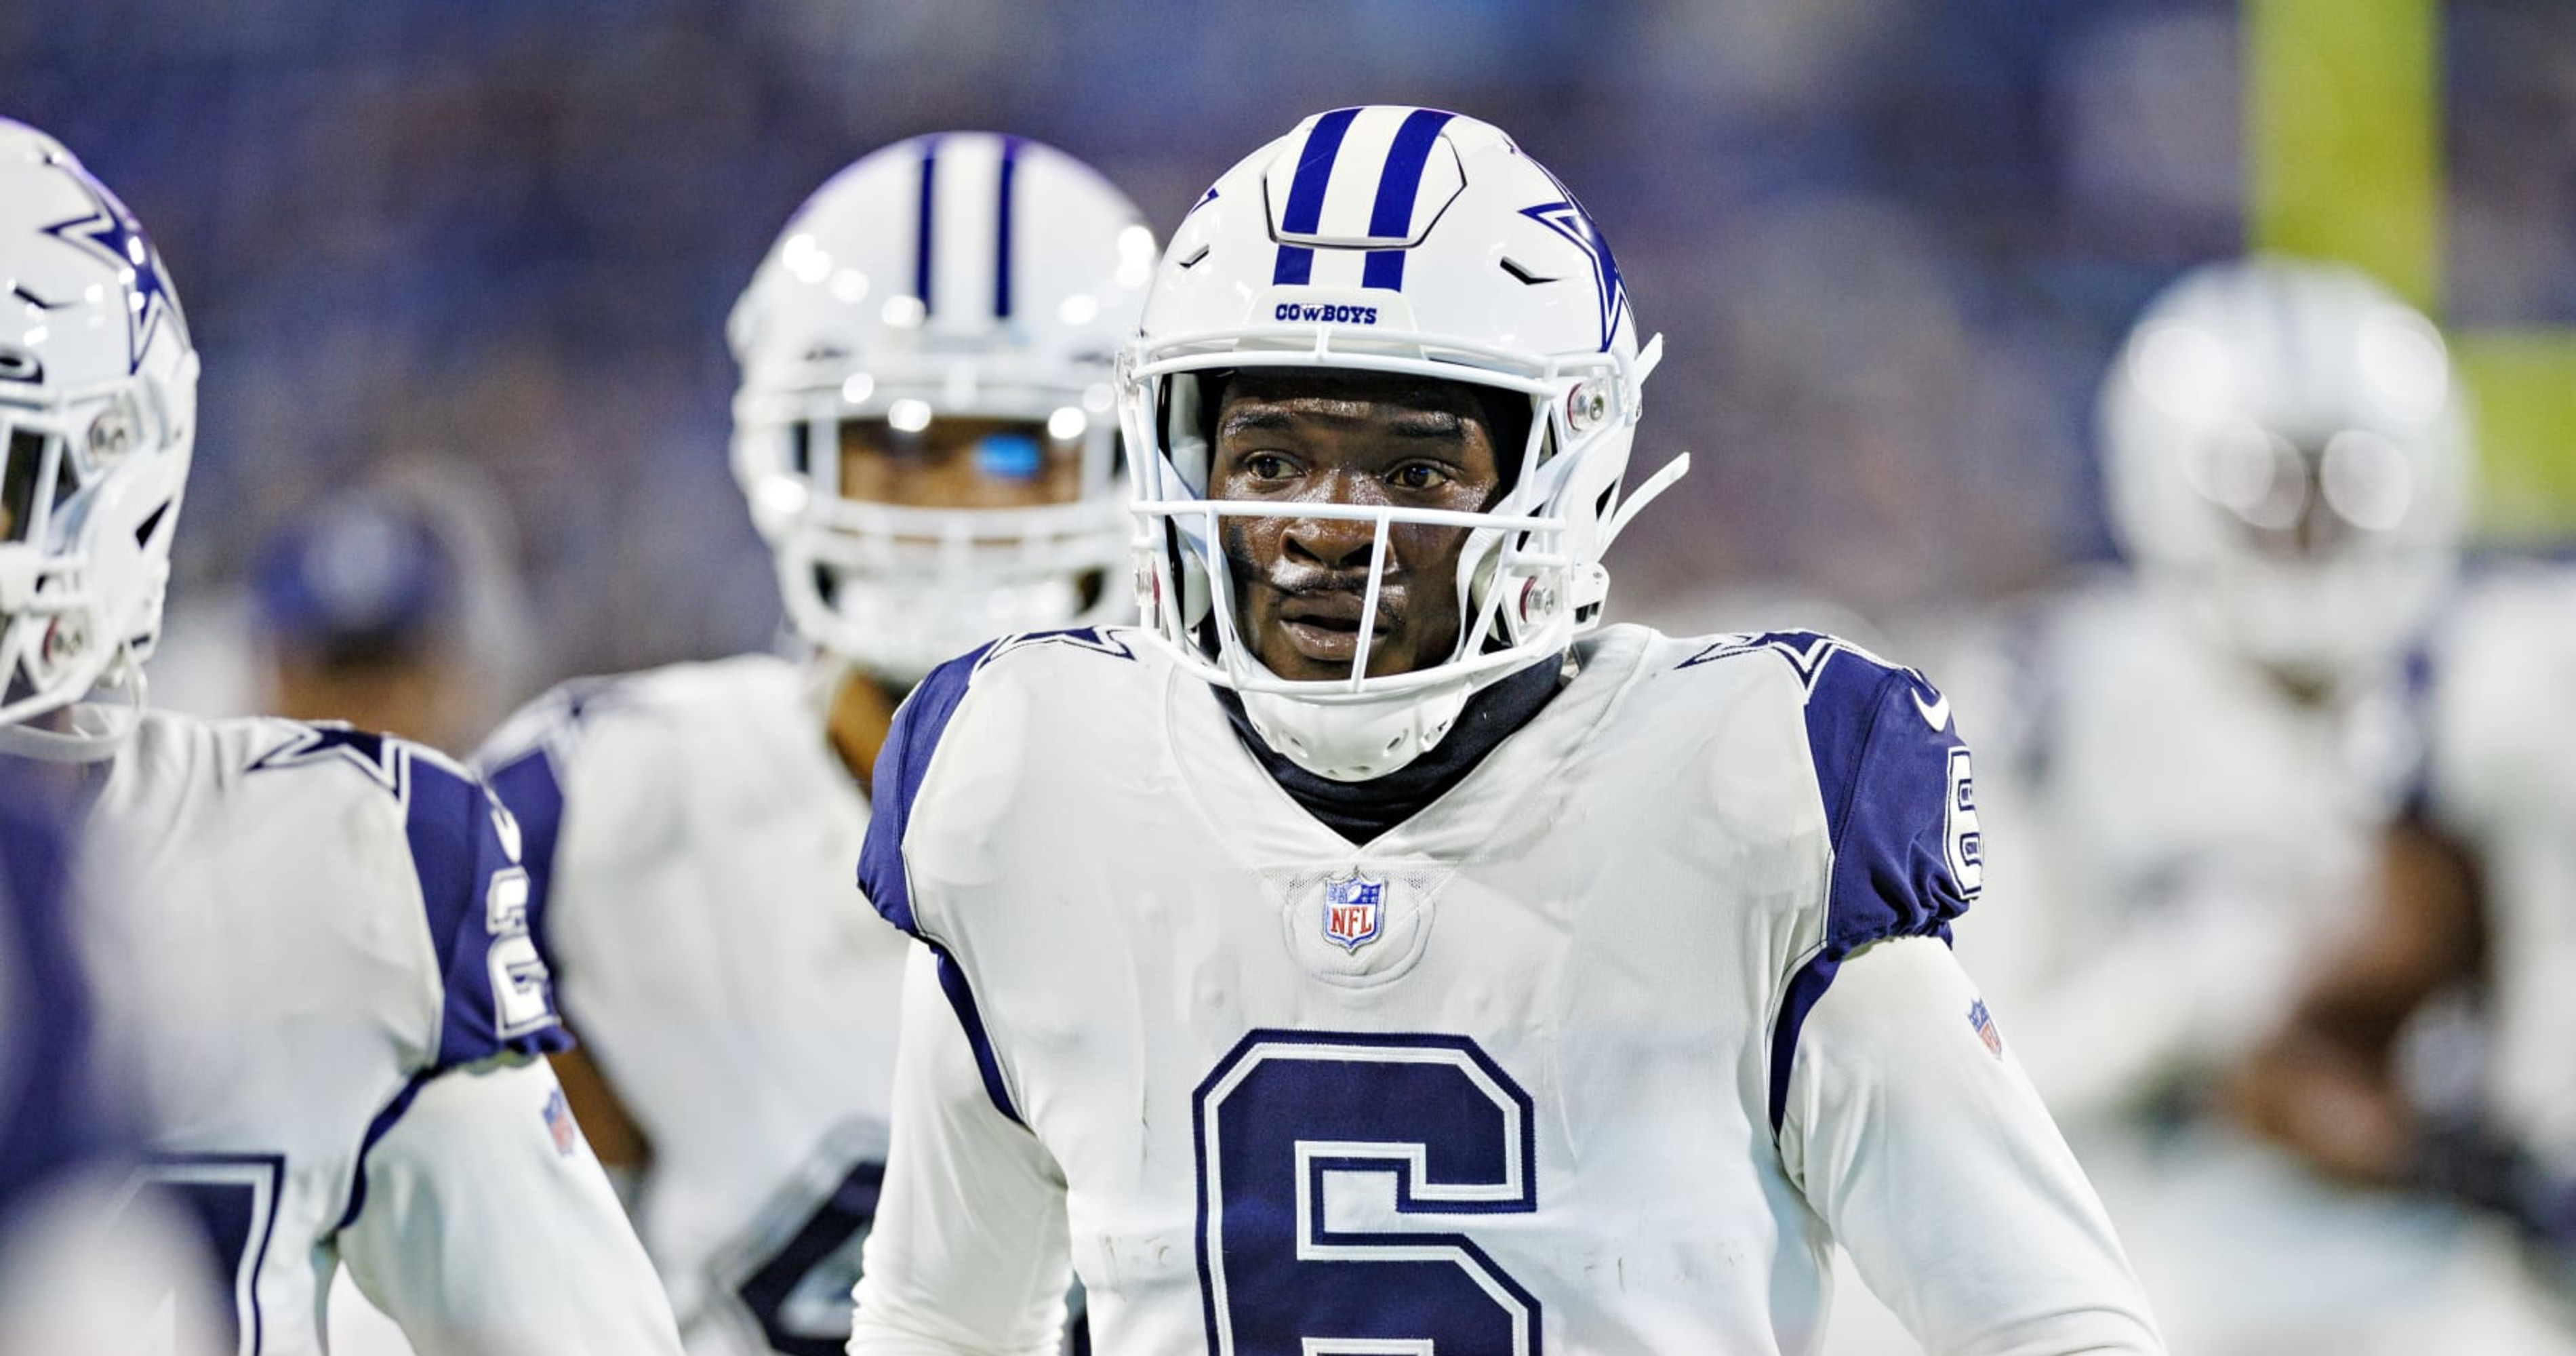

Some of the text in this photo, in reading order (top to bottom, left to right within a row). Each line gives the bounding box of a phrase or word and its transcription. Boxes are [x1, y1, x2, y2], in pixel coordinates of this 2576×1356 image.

[1275, 303, 1377, 325] COWBOYS
[1330, 906, 1372, 937] NFL
[1192, 1028, 1542, 1356] 6
